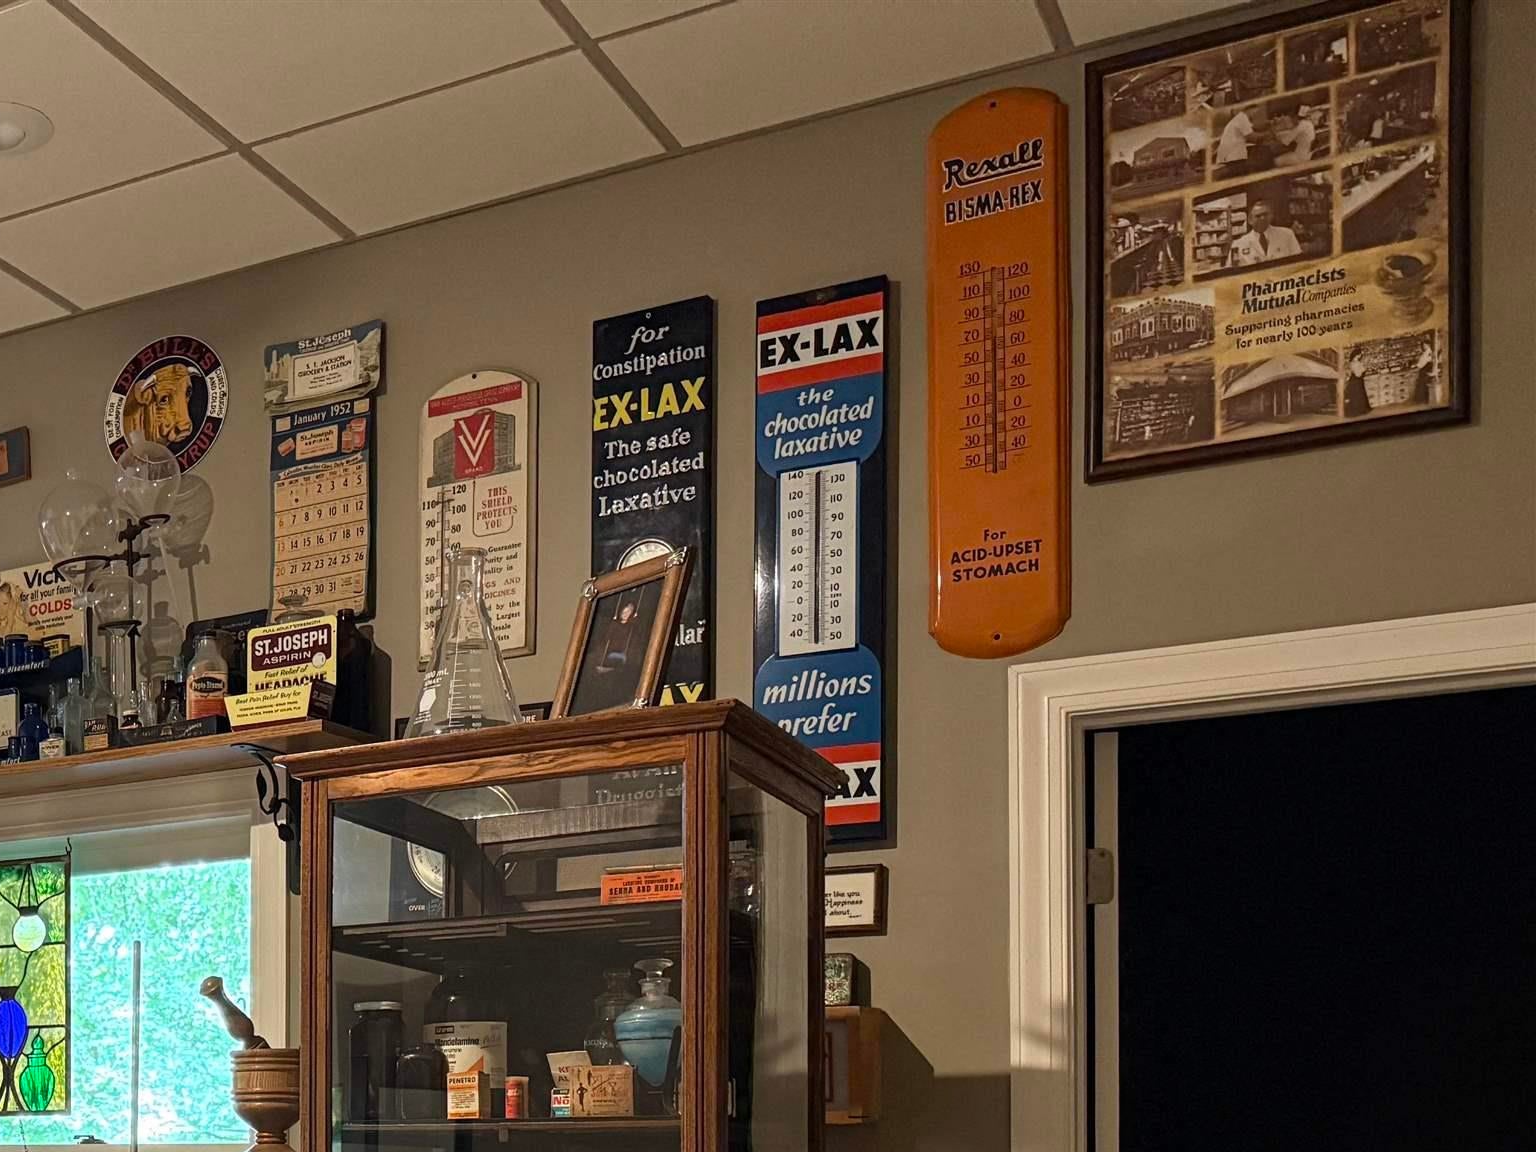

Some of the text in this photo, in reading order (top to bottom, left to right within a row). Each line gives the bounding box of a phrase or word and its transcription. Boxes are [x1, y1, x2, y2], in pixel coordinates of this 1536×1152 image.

[942, 137, 1044, 193] Rexall
[945, 180, 1044, 225] BISMA-REX
[960, 261, 1029, 277] 130 120
[1241, 267, 1346, 299] Pharmacists
[963, 284, 1030, 299] 110 100
[1241, 283, 1358, 314] Mutual Companies
[964, 307, 1025, 322] 90 80
[1224, 302, 1365, 336] Supporting pharmacies
[624, 325, 670, 355] for
[964, 329, 1025, 344] 70 60
[1236, 319, 1353, 349] for nearly 100 years
[760, 316, 880, 369] EX-LAX
[593, 345, 706, 381] Constipation
[964, 351, 1026, 365] 50 40
[964, 372, 1026, 386] 30 20
[593, 376, 706, 432] EX-LAX
[797, 388, 834, 407] the
[965, 393, 1022, 406] 10 0
[294, 402, 351, 426] January 1952
[763, 395, 875, 437] chocolated
[965, 414, 1026, 427] 10 20
[178, 422, 216, 468] YRUP
[604, 427, 692, 460] The safe
[774, 427, 863, 460] laxative
[965, 434, 1026, 447] 30 40
[965, 454, 981, 466] 50
[593, 451, 705, 490] chocolated
[788, 471, 845, 483] 140 130
[451, 484, 467, 495] 120
[487, 486, 508, 498] THIS
[789, 491, 843, 503] 120 110
[481, 495, 513, 509] SHIELD
[598, 484, 697, 517] Laxative
[451, 504, 467, 515] 100
[477, 505, 518, 520] PROTECTS
[787, 510, 844, 522] 100 90
[484, 519, 503, 530] YOU
[983, 528, 1007, 542] For
[506, 552, 518, 560] and
[950, 539, 1043, 565] ACID-UPSET
[952, 558, 1040, 583] STOMACH
[24, 568, 68, 589] VICK
[504, 577, 521, 586] AND
[30, 589, 39, 599] all
[39, 587, 55, 599] your
[29, 598, 72, 617] COLDS
[496, 600, 521, 610] by the
[496, 611, 521, 621] Largest
[254, 628, 328, 656] ST.JOSEPH
[262, 650, 312, 666] ASPIRIN
[7, 661, 45, 673] discomfort
[264, 665, 309, 679] Fast Relief of
[763, 669, 872, 705] millions
[249, 696, 262, 704] Pain
[262, 693, 279, 702] Relief
[280, 691, 292, 700] Buy
[292, 690, 302, 698] for
[654, 883, 683, 892] RHUBAR
[833, 890, 860, 899] like you
[448, 1076, 477, 1085] PENETRO
